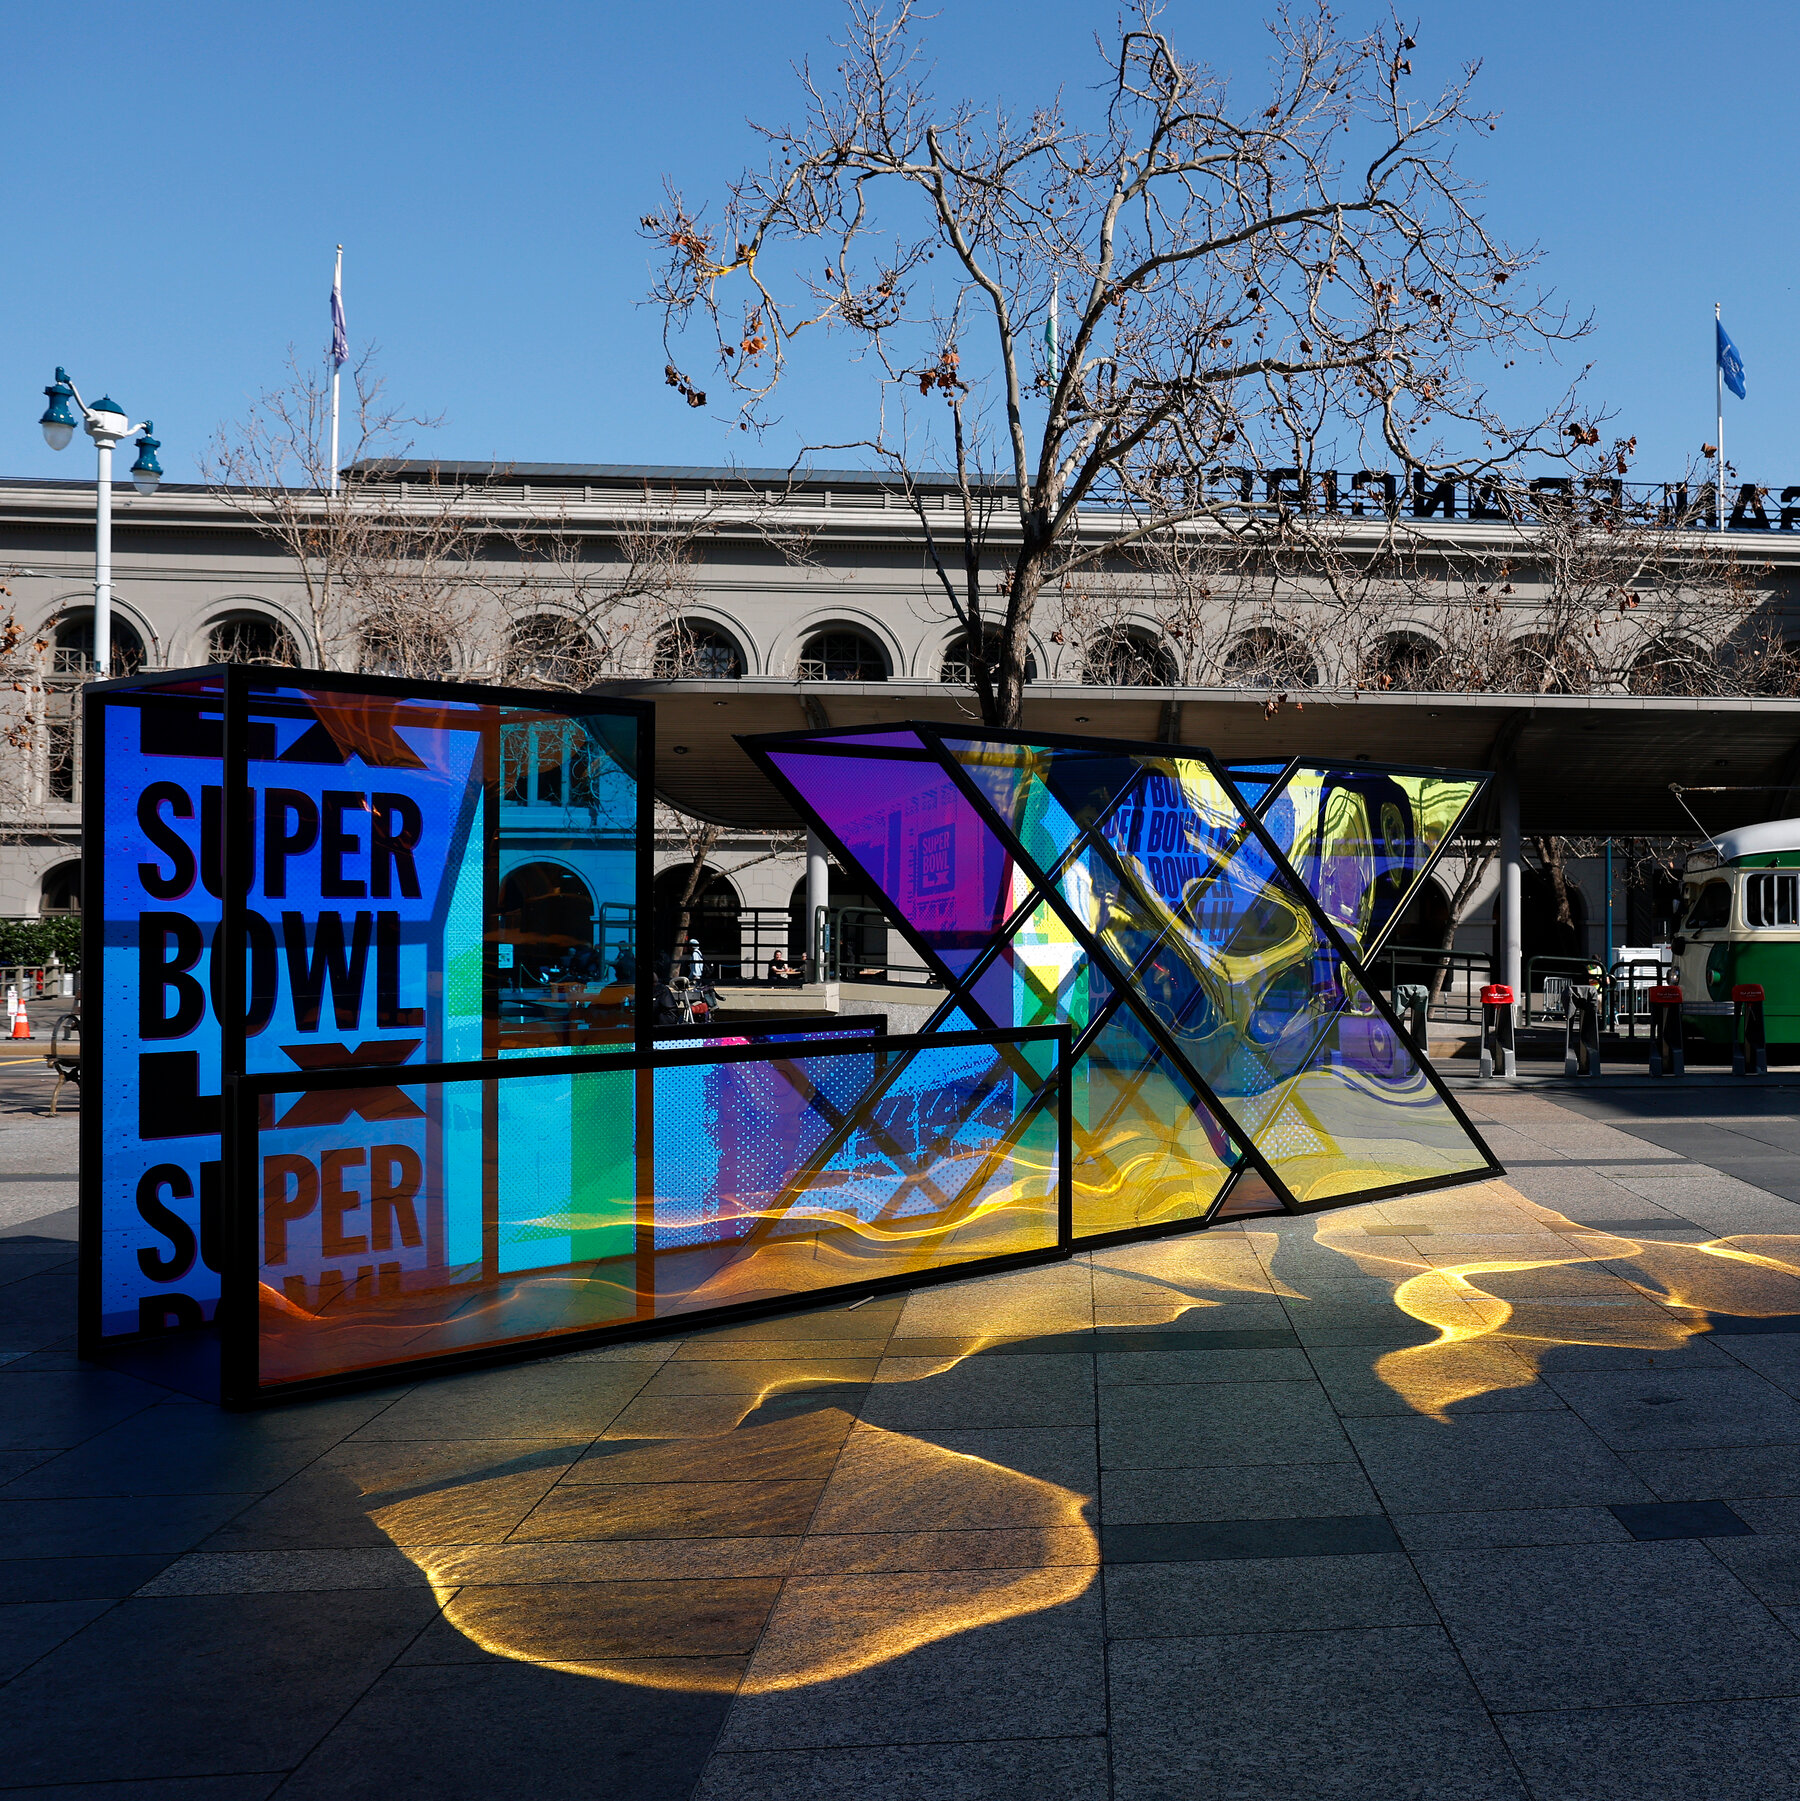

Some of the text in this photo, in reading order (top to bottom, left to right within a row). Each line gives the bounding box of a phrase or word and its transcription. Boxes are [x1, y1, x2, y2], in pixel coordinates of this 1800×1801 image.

[137, 780, 423, 901] SUPER
[922, 831, 950, 856] SUPER
[923, 850, 950, 875] BOWL
[923, 870, 950, 889] LX
[139, 909, 427, 1041] BOWL
